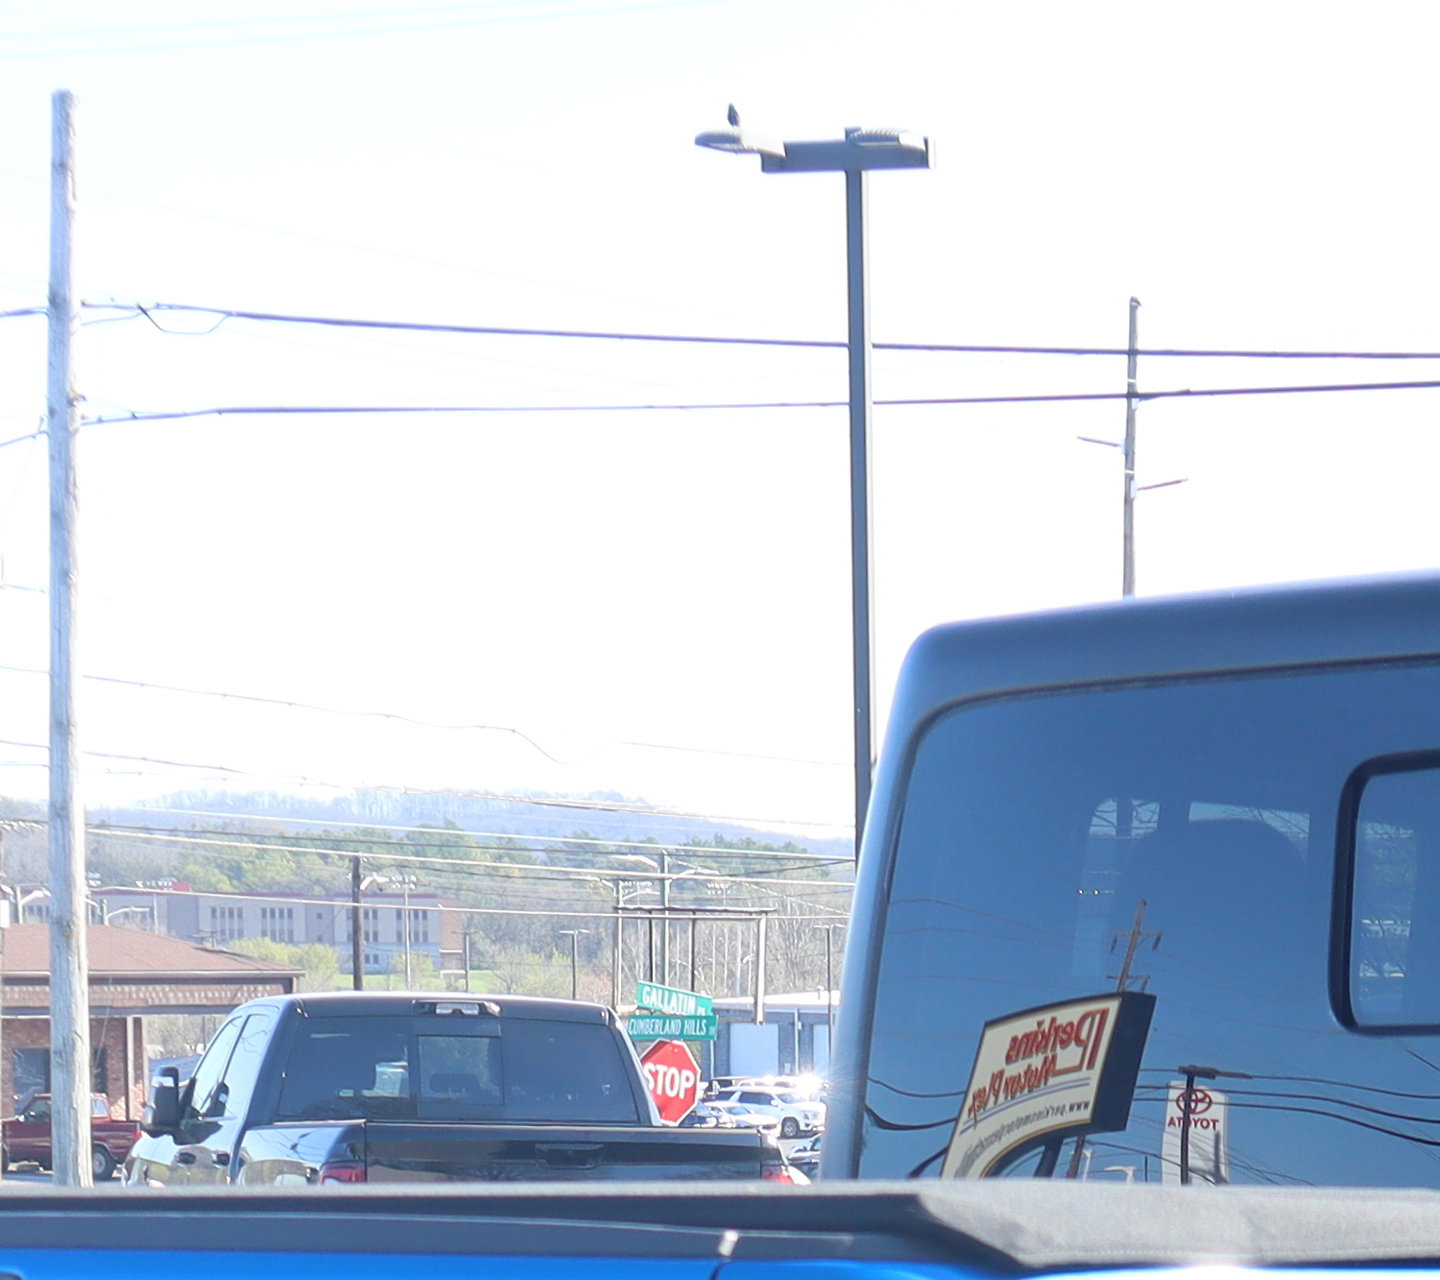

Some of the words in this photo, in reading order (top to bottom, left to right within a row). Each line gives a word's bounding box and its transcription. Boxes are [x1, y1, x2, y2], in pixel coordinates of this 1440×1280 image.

[641, 985, 696, 1016] GALLATIN
[628, 1018, 682, 1036] CUMBERLAND
[683, 1018, 707, 1036] HILLS
[642, 1062, 695, 1099] STOP
